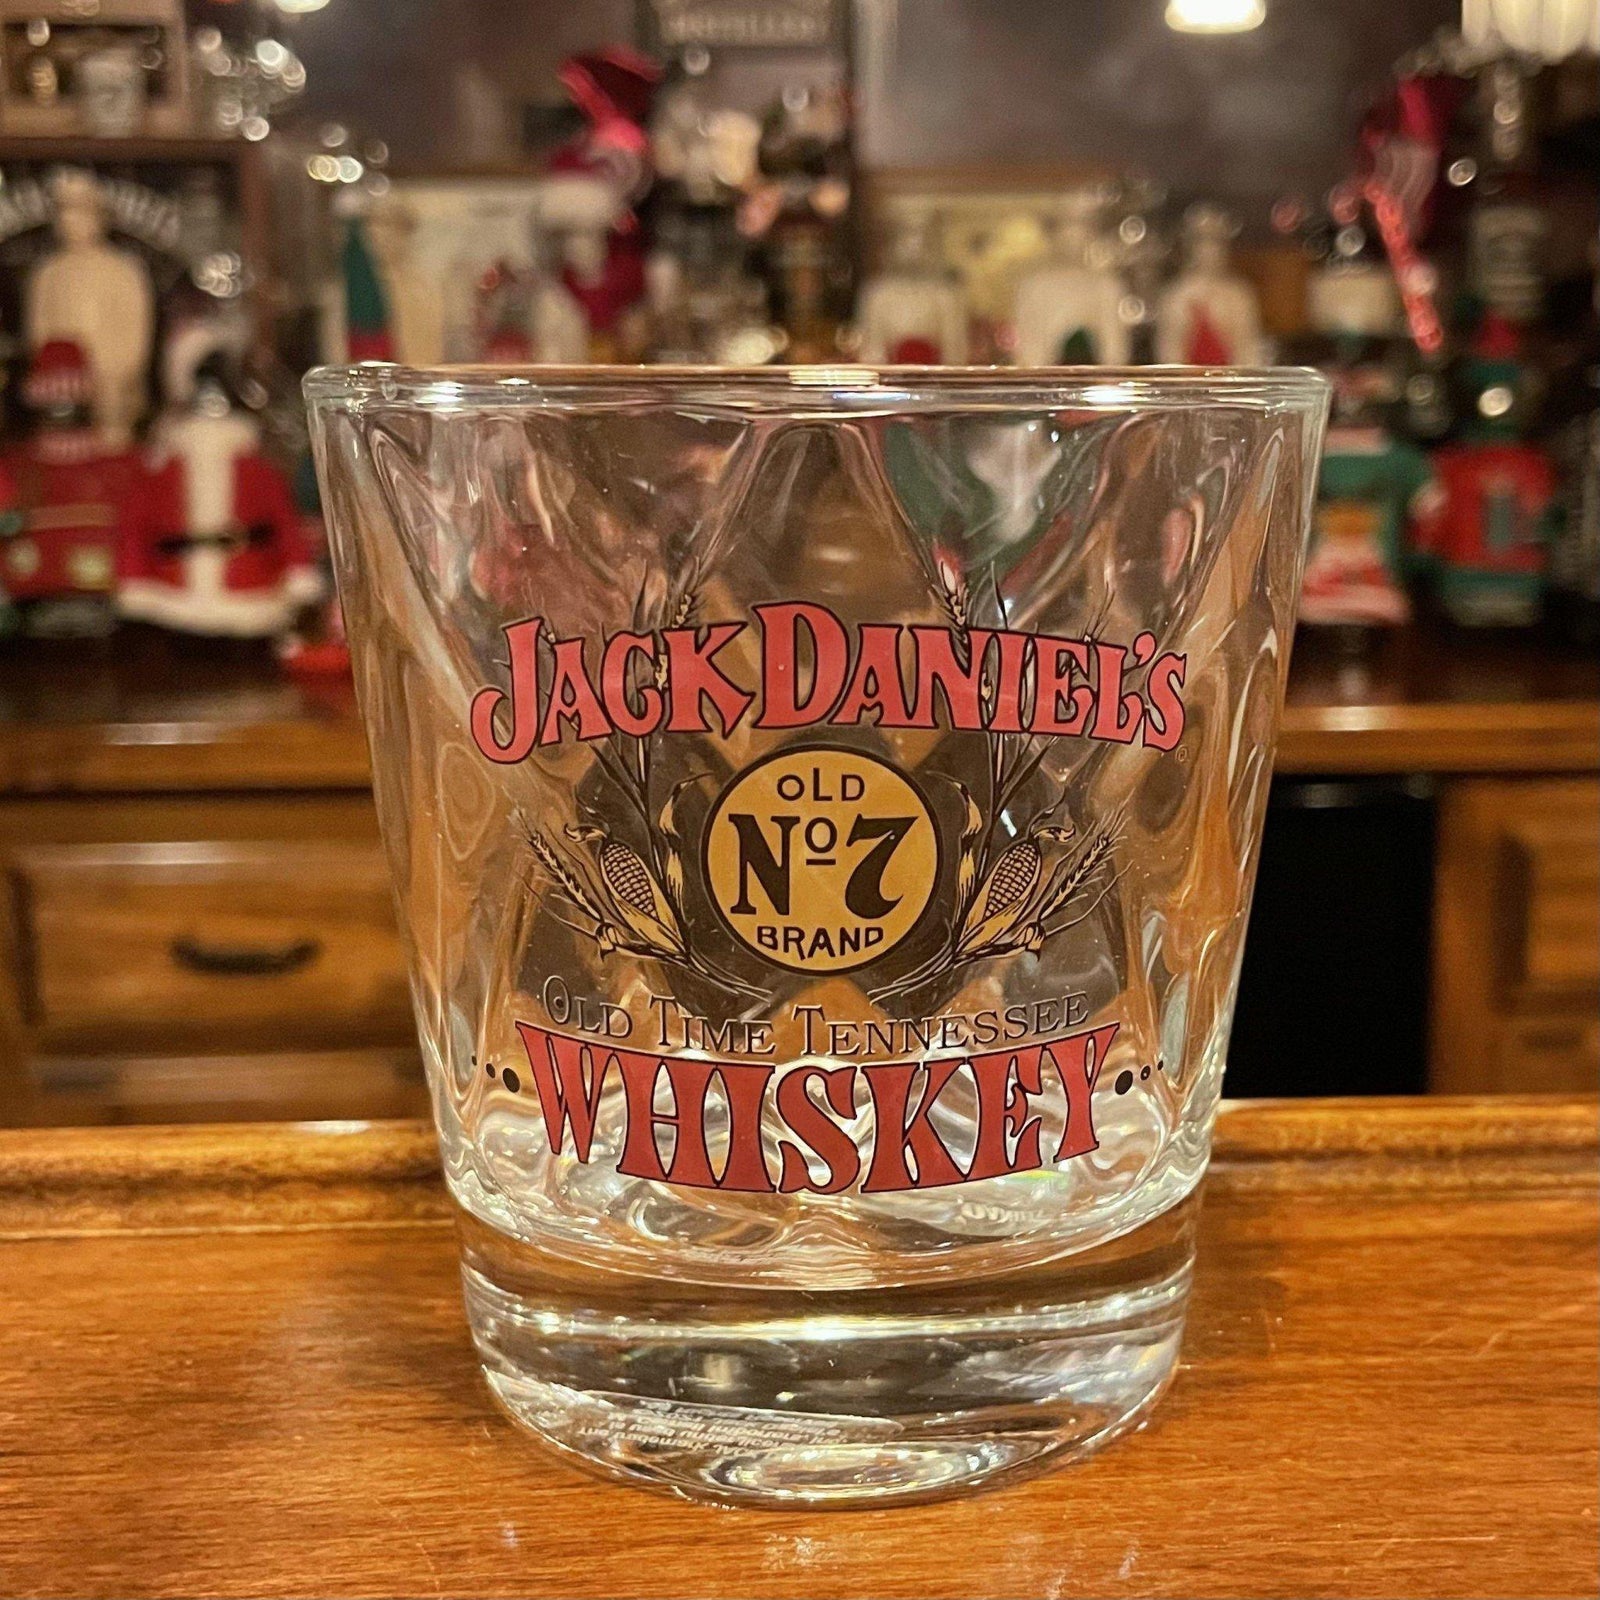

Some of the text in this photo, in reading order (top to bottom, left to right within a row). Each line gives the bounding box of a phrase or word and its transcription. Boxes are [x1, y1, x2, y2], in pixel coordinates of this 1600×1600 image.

[470, 600, 1187, 764] JACK DANIEL'S
[777, 767, 865, 801] OLD
[845, 813, 919, 920] 7
[757, 925, 884, 961] BRAND
[543, 975, 1090, 1057] OLD TIME TENNESSEE
[514, 1020, 1120, 1195] WHISKEY
